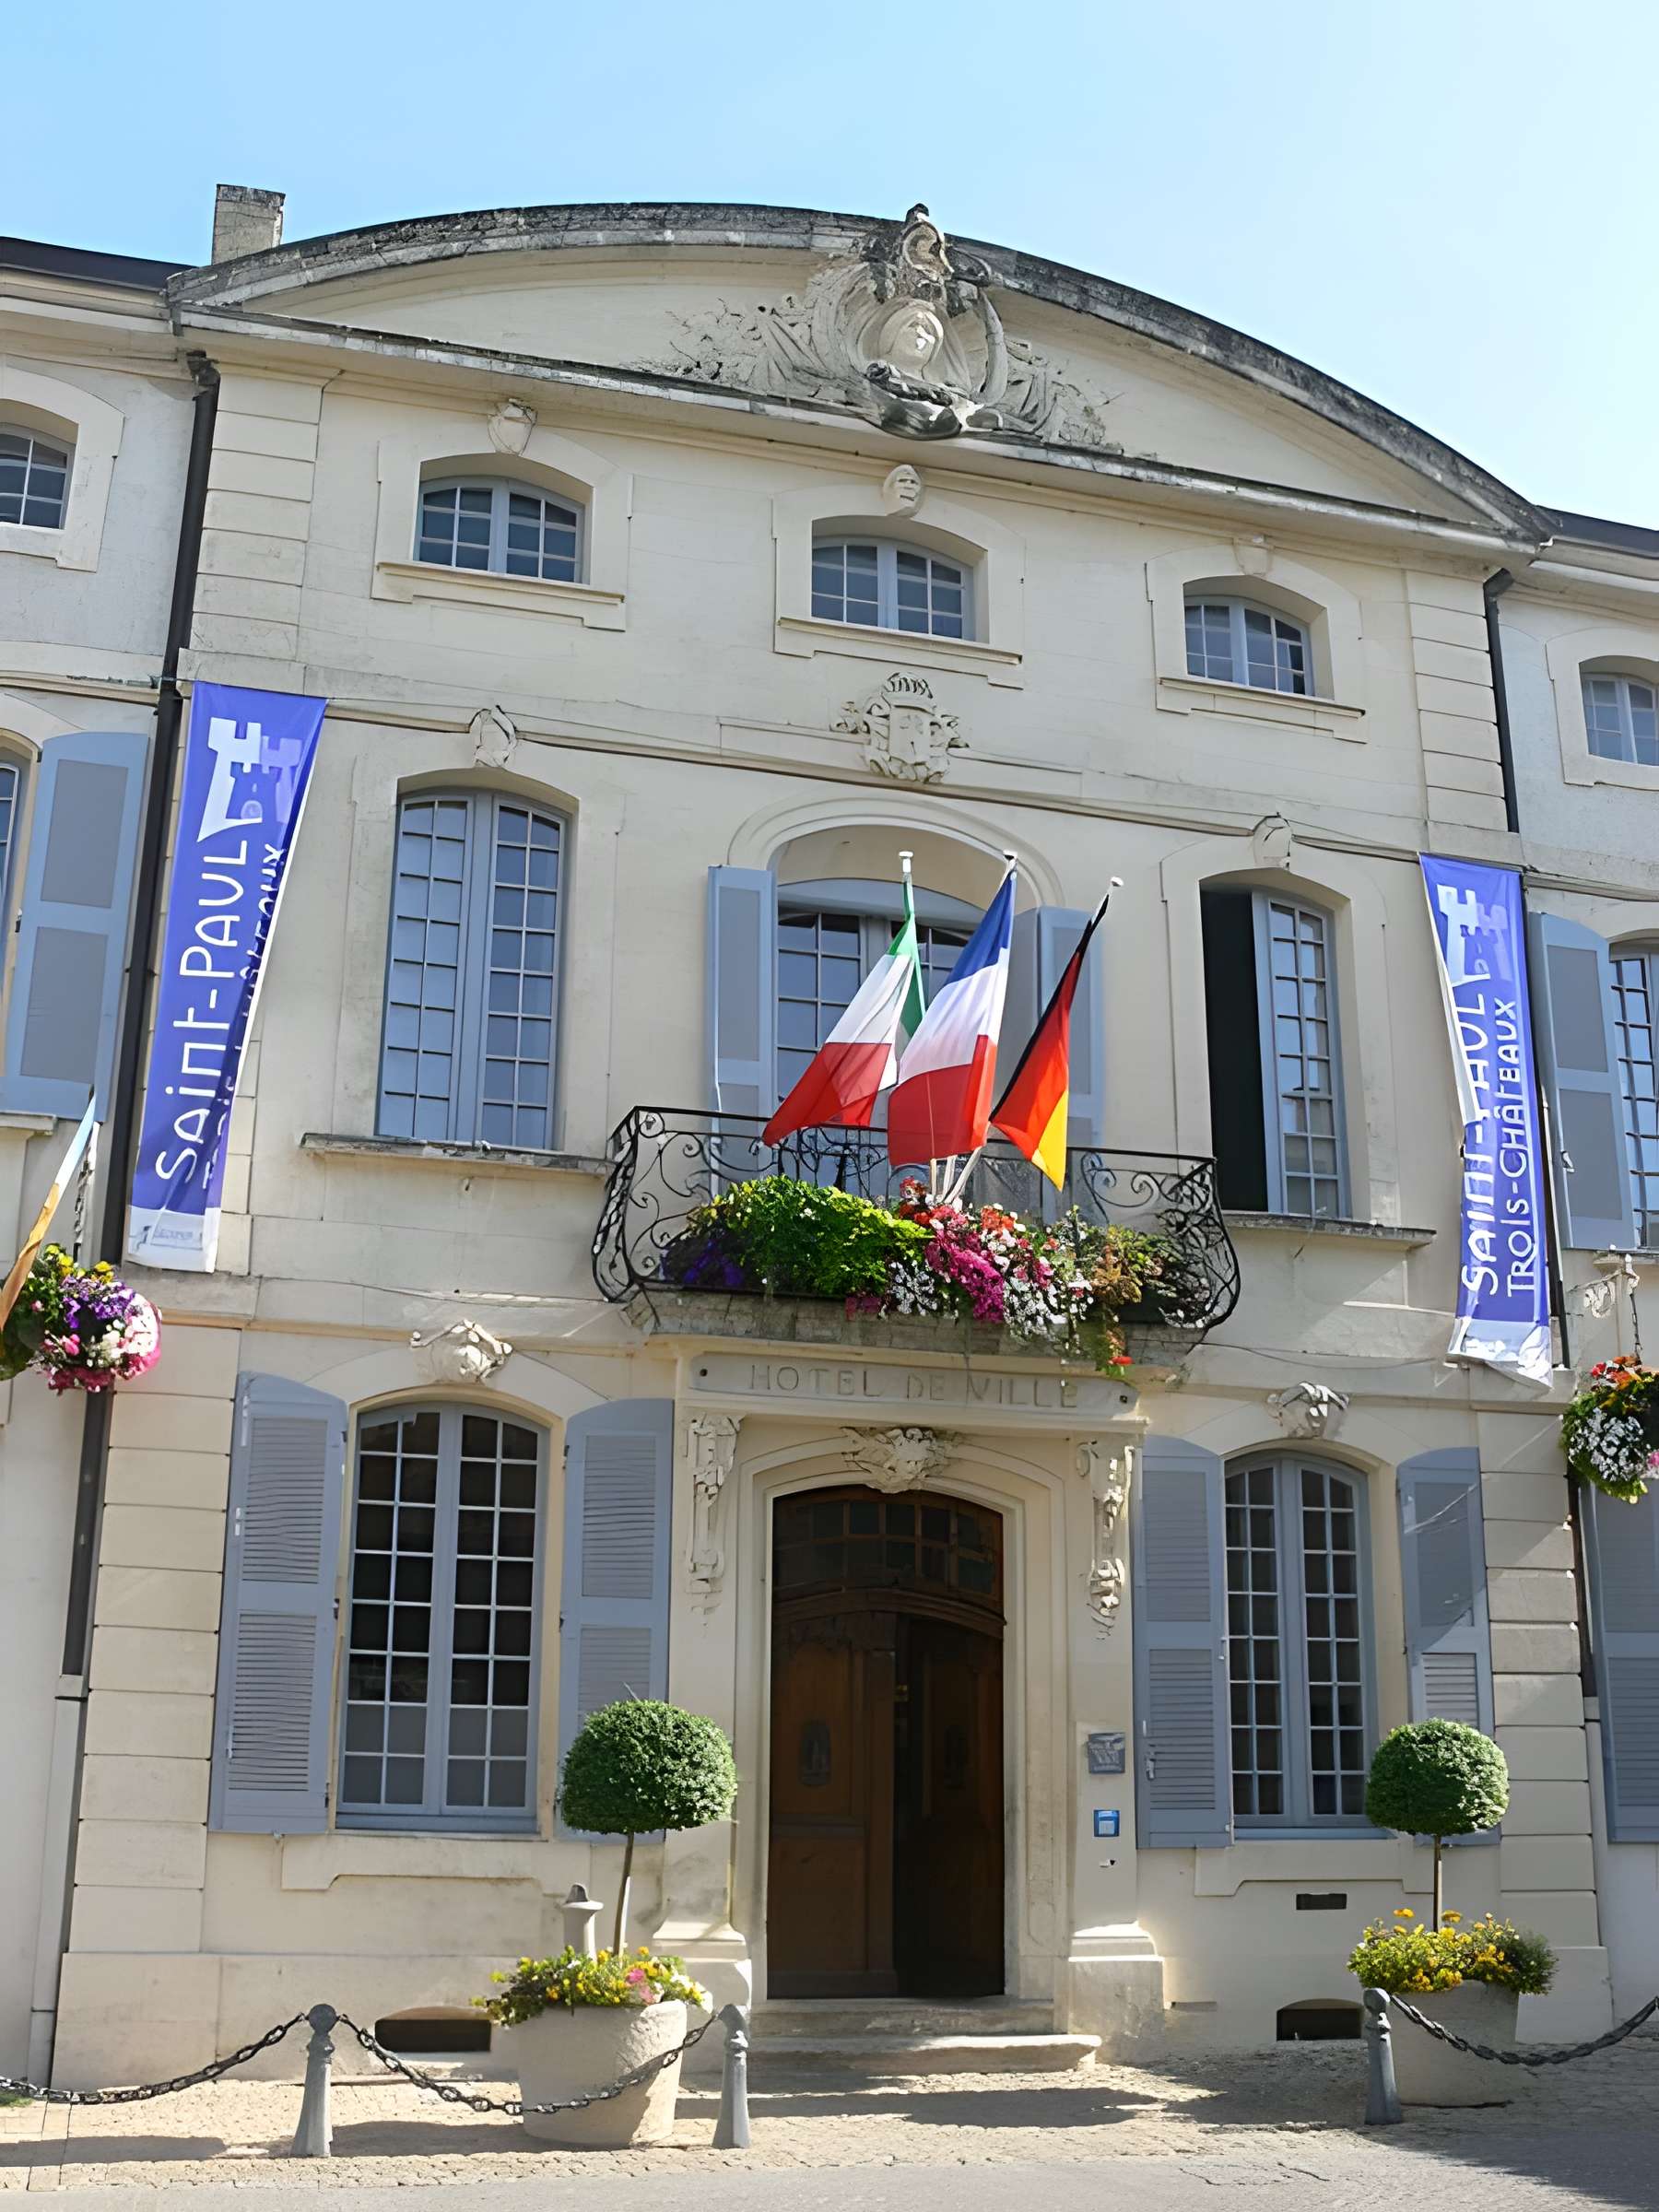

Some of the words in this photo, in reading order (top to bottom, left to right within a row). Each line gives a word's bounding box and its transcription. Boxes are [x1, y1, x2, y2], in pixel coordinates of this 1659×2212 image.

[749, 1364, 882, 1397] HOTEL
[906, 1372, 946, 1401] DE
[966, 1370, 1079, 1408] VILLE
